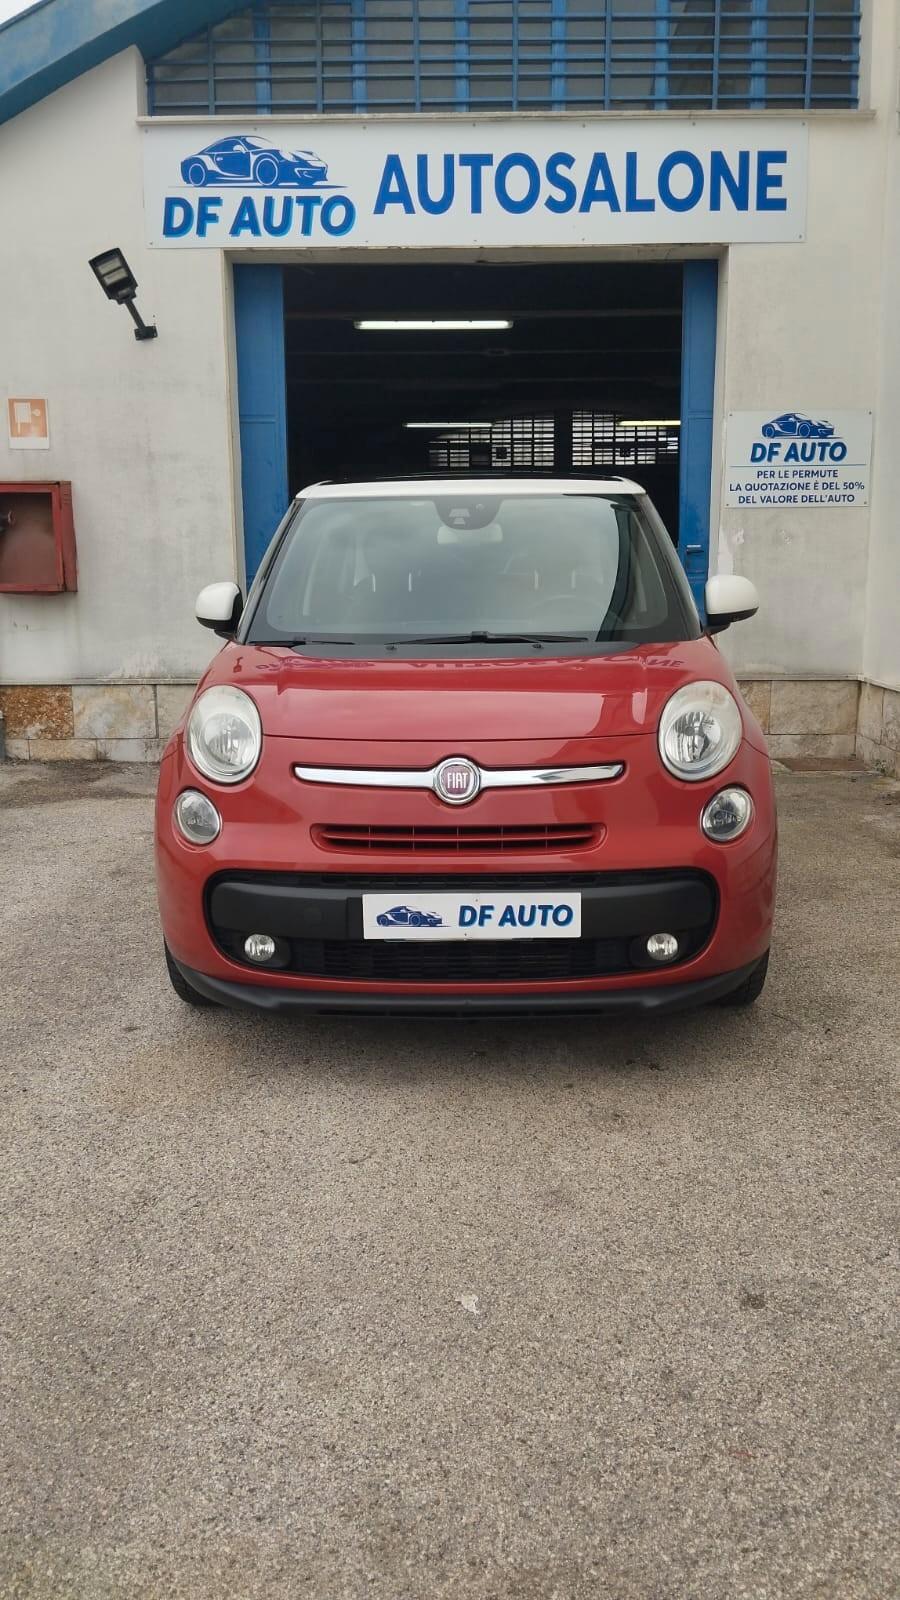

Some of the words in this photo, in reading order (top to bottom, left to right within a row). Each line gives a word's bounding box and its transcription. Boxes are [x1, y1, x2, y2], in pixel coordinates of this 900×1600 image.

[372, 150, 788, 215] AUTOSALONE
[163, 196, 221, 238] DF
[229, 195, 356, 237] AUTO
[750, 443, 781, 463] DF
[784, 441, 847, 462] AUTO
[757, 471, 775, 479] PER
[778, 470, 790, 479] LE
[792, 469, 838, 478] PERMUTE
[729, 484, 742, 492] LA
[744, 482, 811, 492] QUOTAZIONE
[813, 480, 819, 490] È
[821, 482, 840, 490] DEL
[843, 481, 865, 490] 50%
[738, 495, 757, 504] DEL
[760, 495, 798, 503] VALORE
[801, 494, 855, 503] DELL'AUTO
[447, 772, 469, 789] FIAT
[458, 905, 494, 927] DF
[499, 904, 574, 926] AUTO
